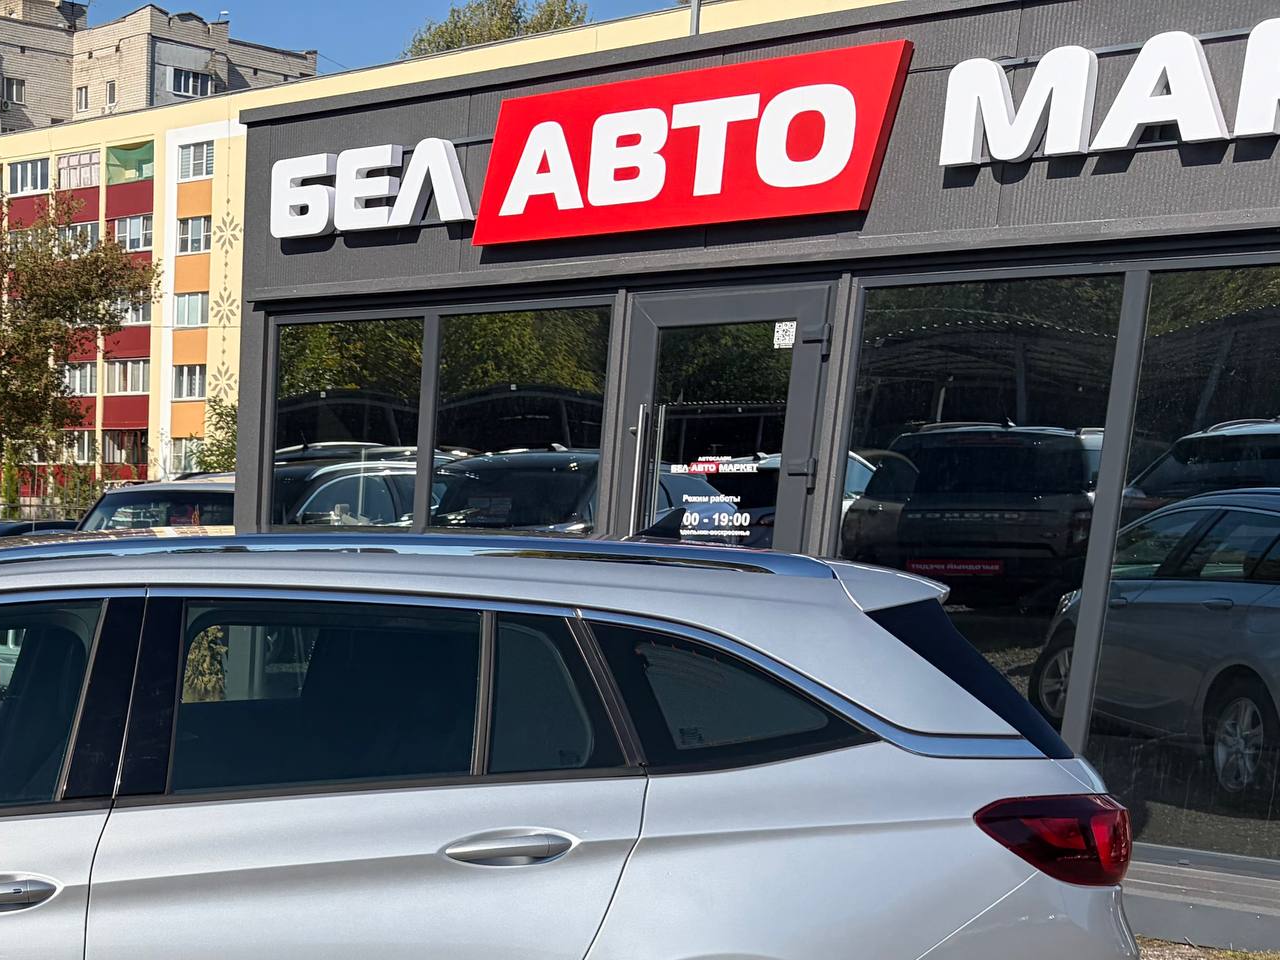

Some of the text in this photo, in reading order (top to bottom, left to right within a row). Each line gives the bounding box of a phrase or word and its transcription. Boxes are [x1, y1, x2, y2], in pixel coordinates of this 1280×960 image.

[269, 137, 475, 240] БЕЛ
[498, 82, 857, 217] АВТО
[690, 463, 717, 472] АВТО
[718, 463, 759, 473] МАРКЕТ
[682, 494, 741, 504] Режим работы
[682, 512, 700, 526] 00
[712, 512, 751, 527] 19:00
